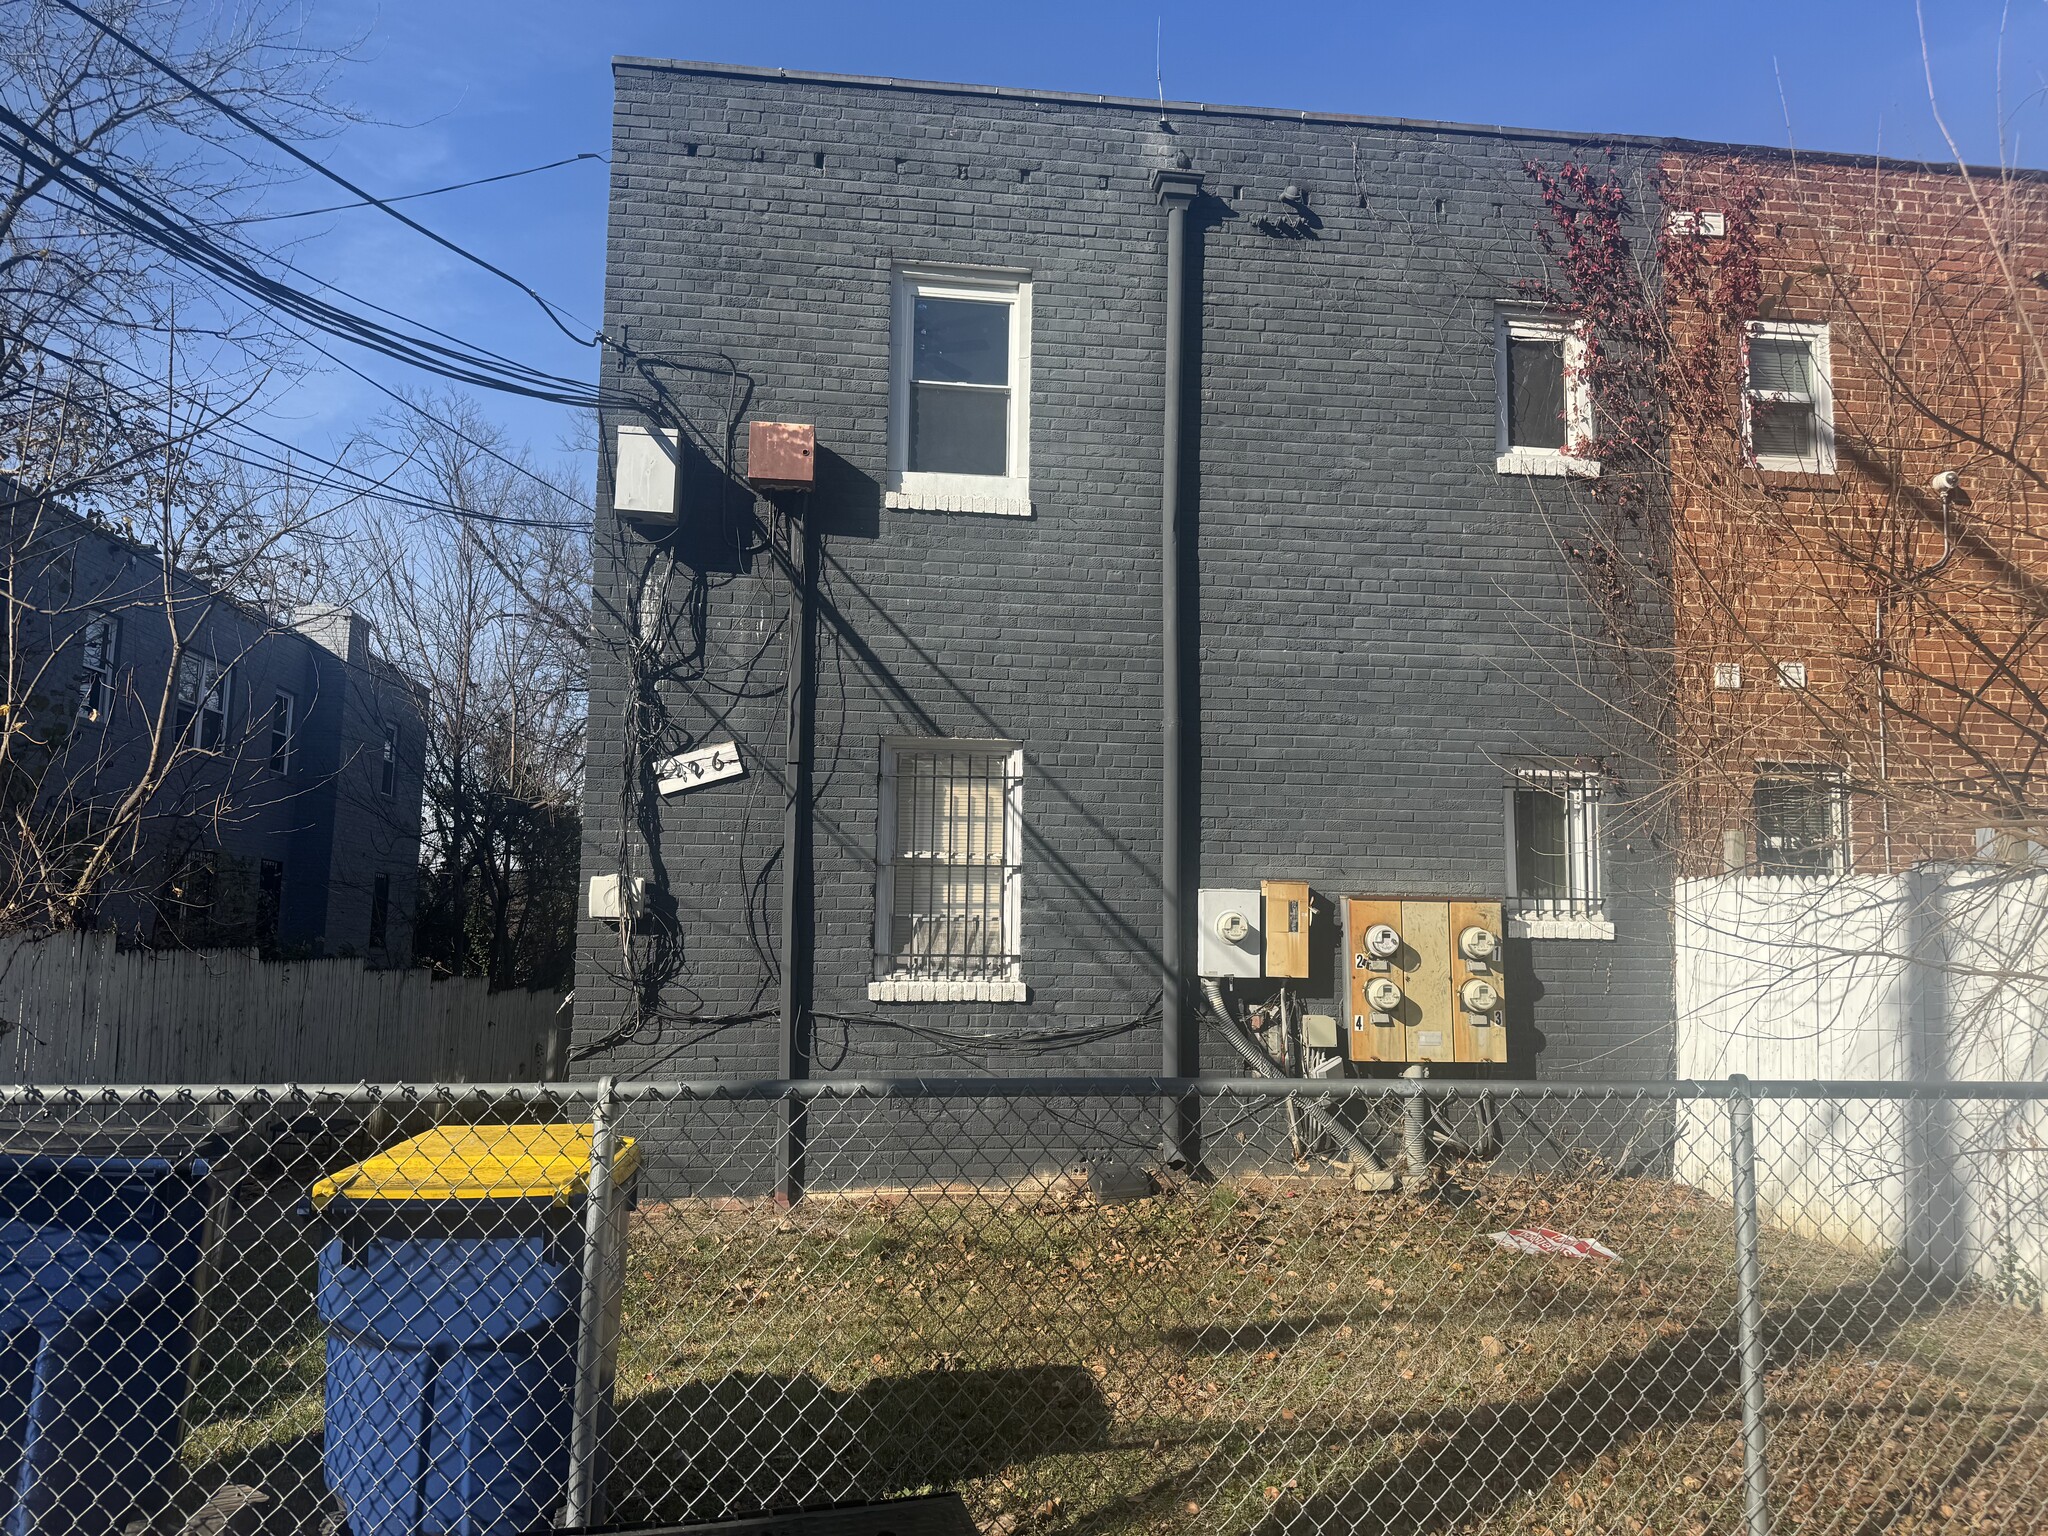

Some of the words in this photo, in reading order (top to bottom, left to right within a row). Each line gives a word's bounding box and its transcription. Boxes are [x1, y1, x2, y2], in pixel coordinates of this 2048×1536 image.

[1494, 946, 1500, 961] 1
[1356, 954, 1364, 969] 2
[1356, 1015, 1362, 1031] 4
[1495, 1011, 1502, 1025] 3
